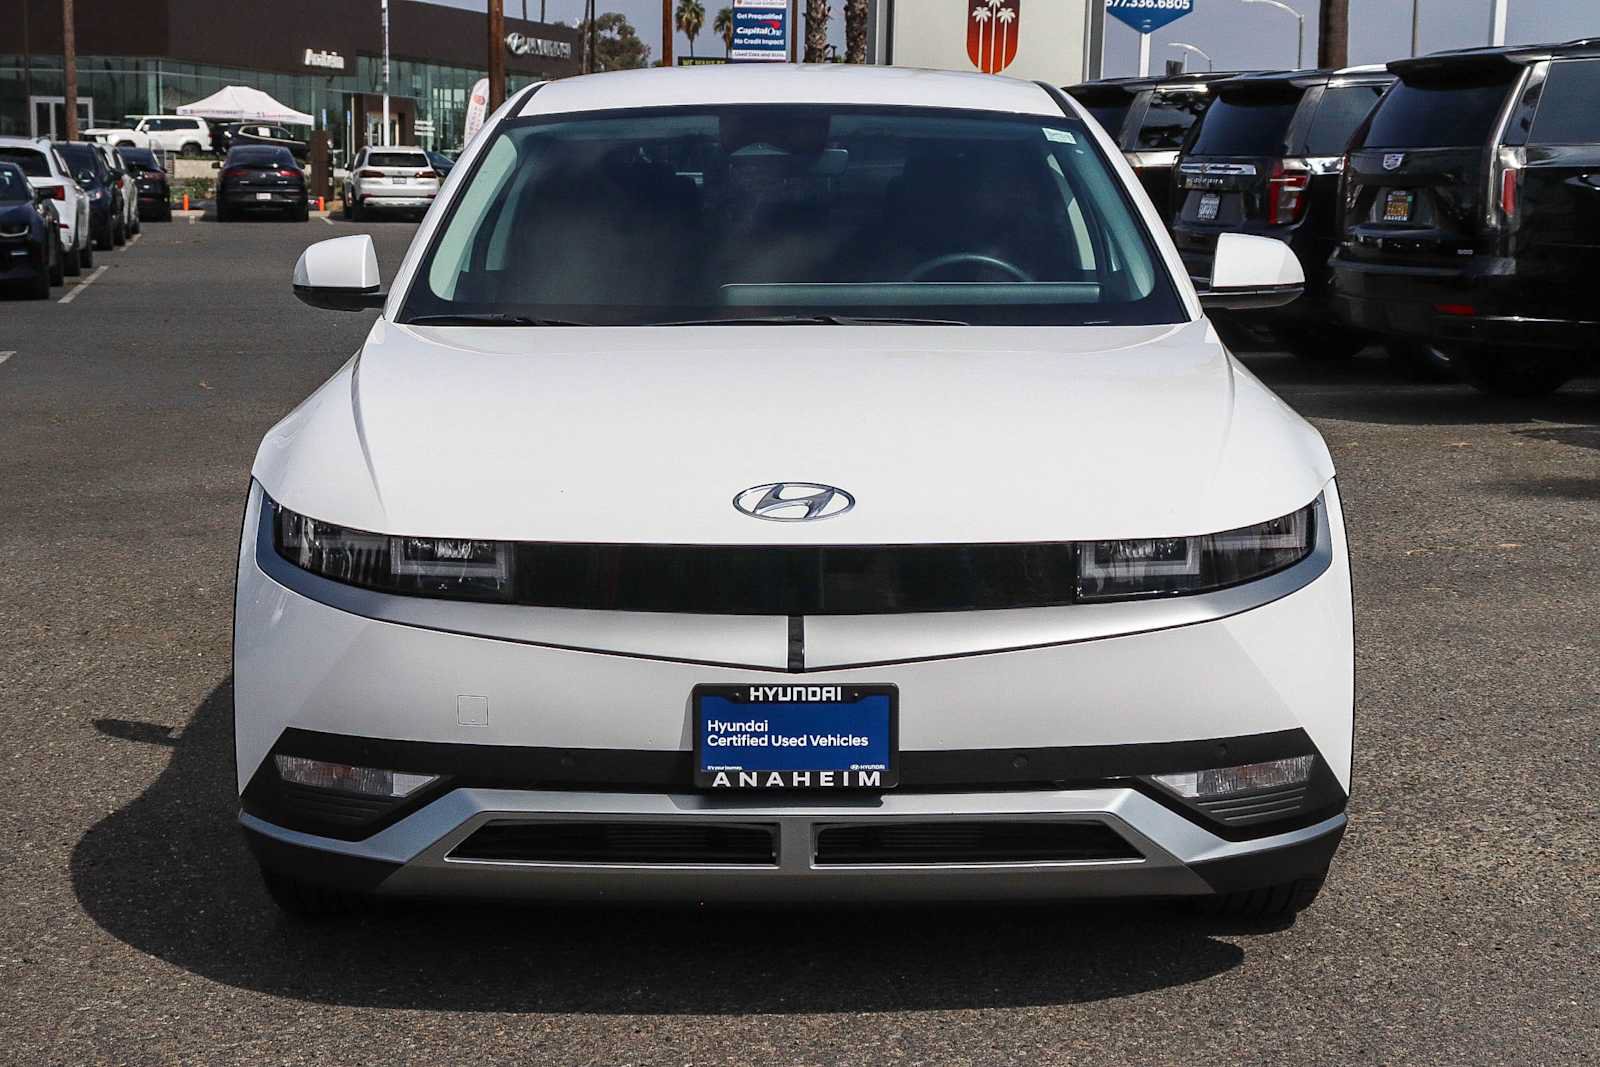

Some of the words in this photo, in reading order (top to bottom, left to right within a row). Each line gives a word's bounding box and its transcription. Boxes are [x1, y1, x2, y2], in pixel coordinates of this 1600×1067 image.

[750, 686, 842, 702] HYUNDAI
[707, 719, 769, 734] Hyundai
[707, 734, 769, 747] Certified
[771, 734, 807, 747] Used
[809, 734, 869, 747] Vehicles
[711, 771, 882, 788] ANAHEIM
